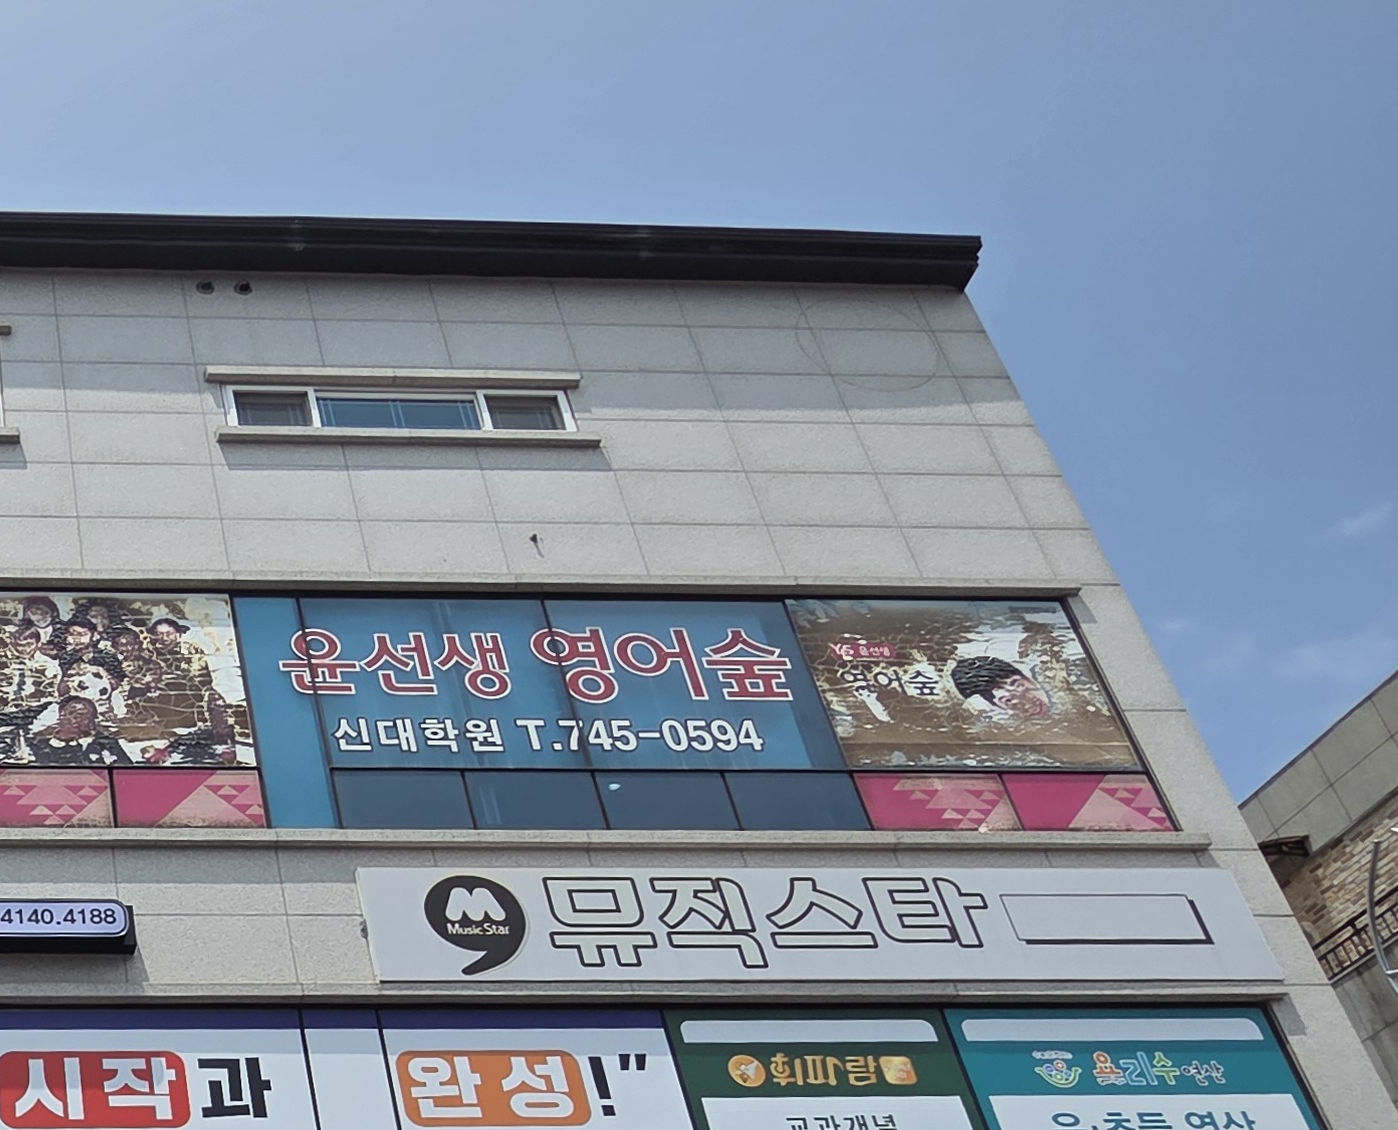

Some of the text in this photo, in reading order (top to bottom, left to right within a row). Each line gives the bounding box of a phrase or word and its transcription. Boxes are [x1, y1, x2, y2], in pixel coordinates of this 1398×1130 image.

[278, 626, 794, 704] 윤선생 영어숲
[332, 717, 764, 753] 신대학원 T.745-0594
[446, 922, 510, 935] Music Star
[541, 876, 989, 969] 뮤직스타
[15, 1055, 272, 1121] 시작과
[770, 1052, 878, 1087] 휘파람
